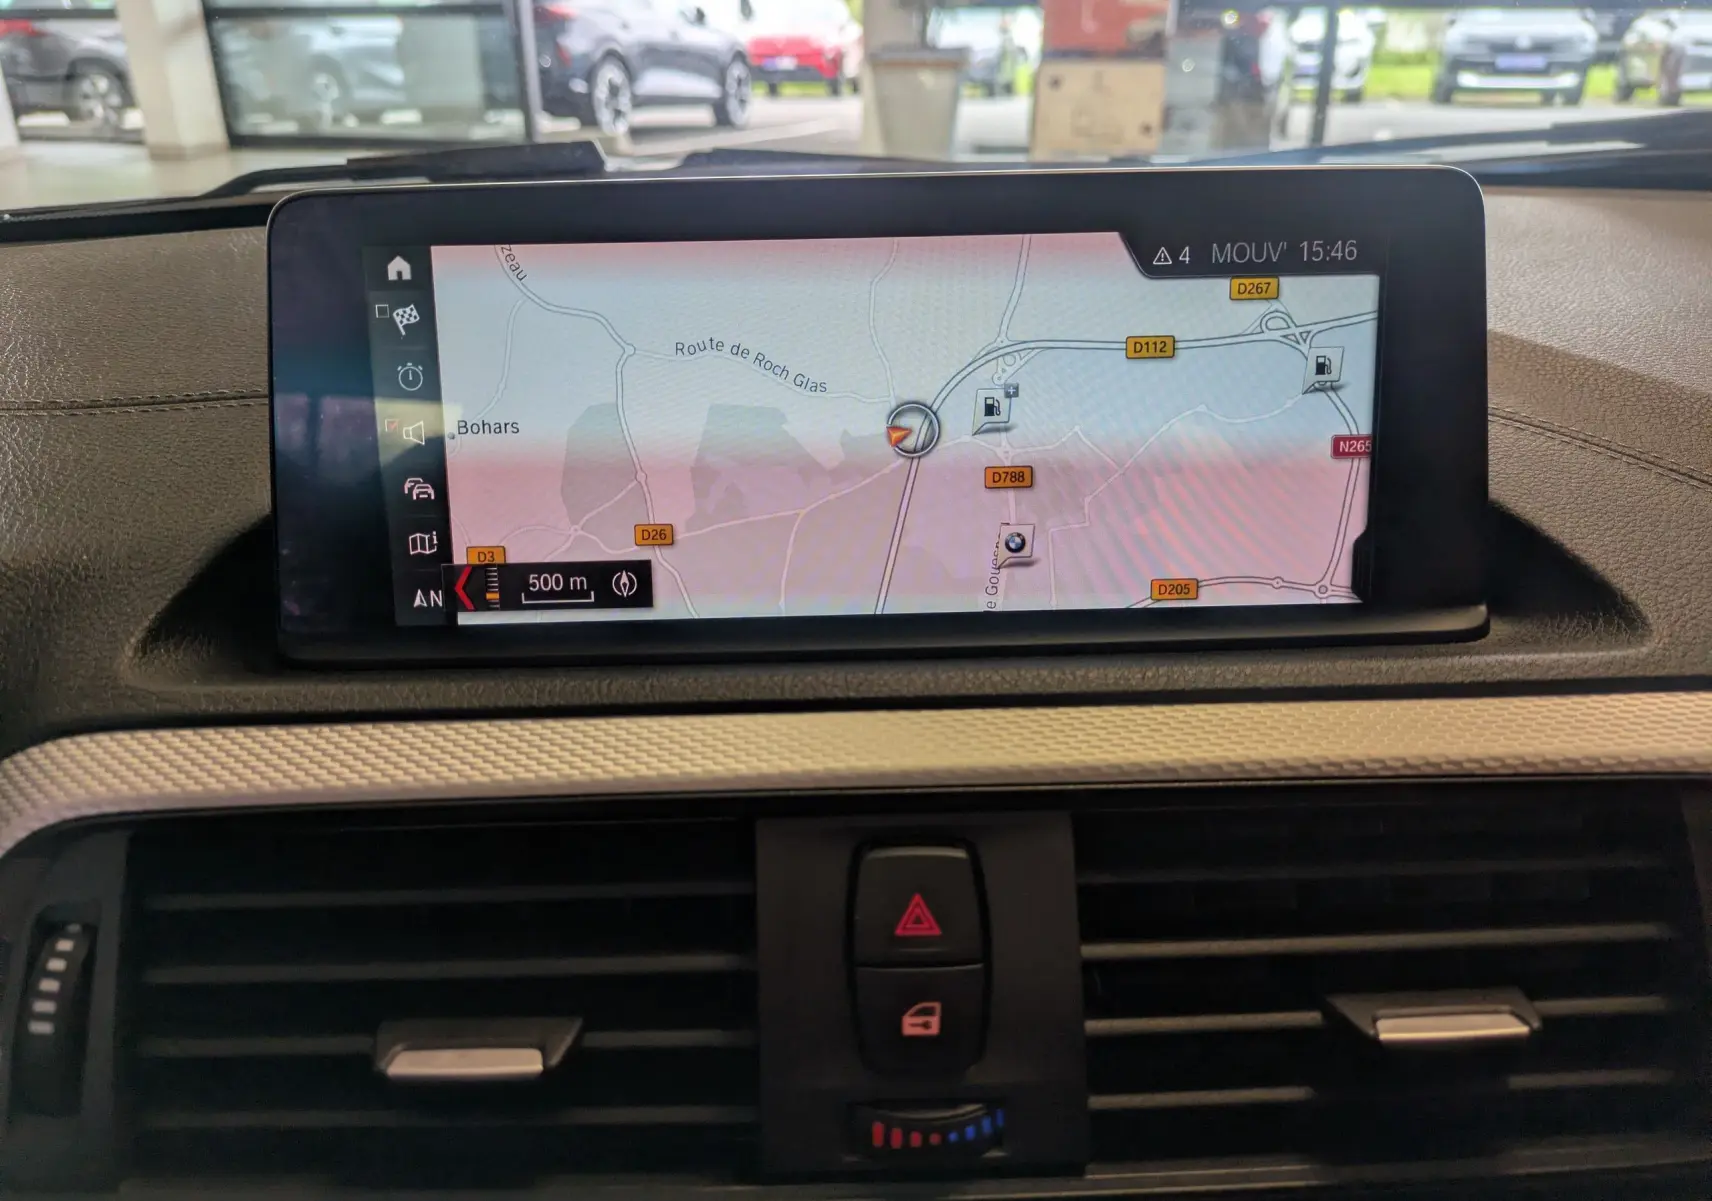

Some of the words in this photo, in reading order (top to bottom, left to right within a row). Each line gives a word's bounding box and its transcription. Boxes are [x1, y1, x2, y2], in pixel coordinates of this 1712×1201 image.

[1178, 246, 1191, 264] 4
[1211, 241, 1288, 264] MOUV'
[1299, 239, 1359, 262] 15:46
[1237, 282, 1271, 296] D267
[1133, 340, 1167, 355] D112
[674, 336, 725, 356] Route
[730, 343, 751, 359] de
[752, 352, 790, 380] Roch
[793, 373, 828, 393] Glas
[457, 419, 520, 436] Bohars
[1339, 440, 1372, 453] N265
[992, 470, 1025, 484] D788
[641, 529, 667, 541] D26
[477, 550, 496, 564] D3
[528, 573, 564, 592] 500
[569, 576, 588, 591] m
[1158, 583, 1191, 597] D205
